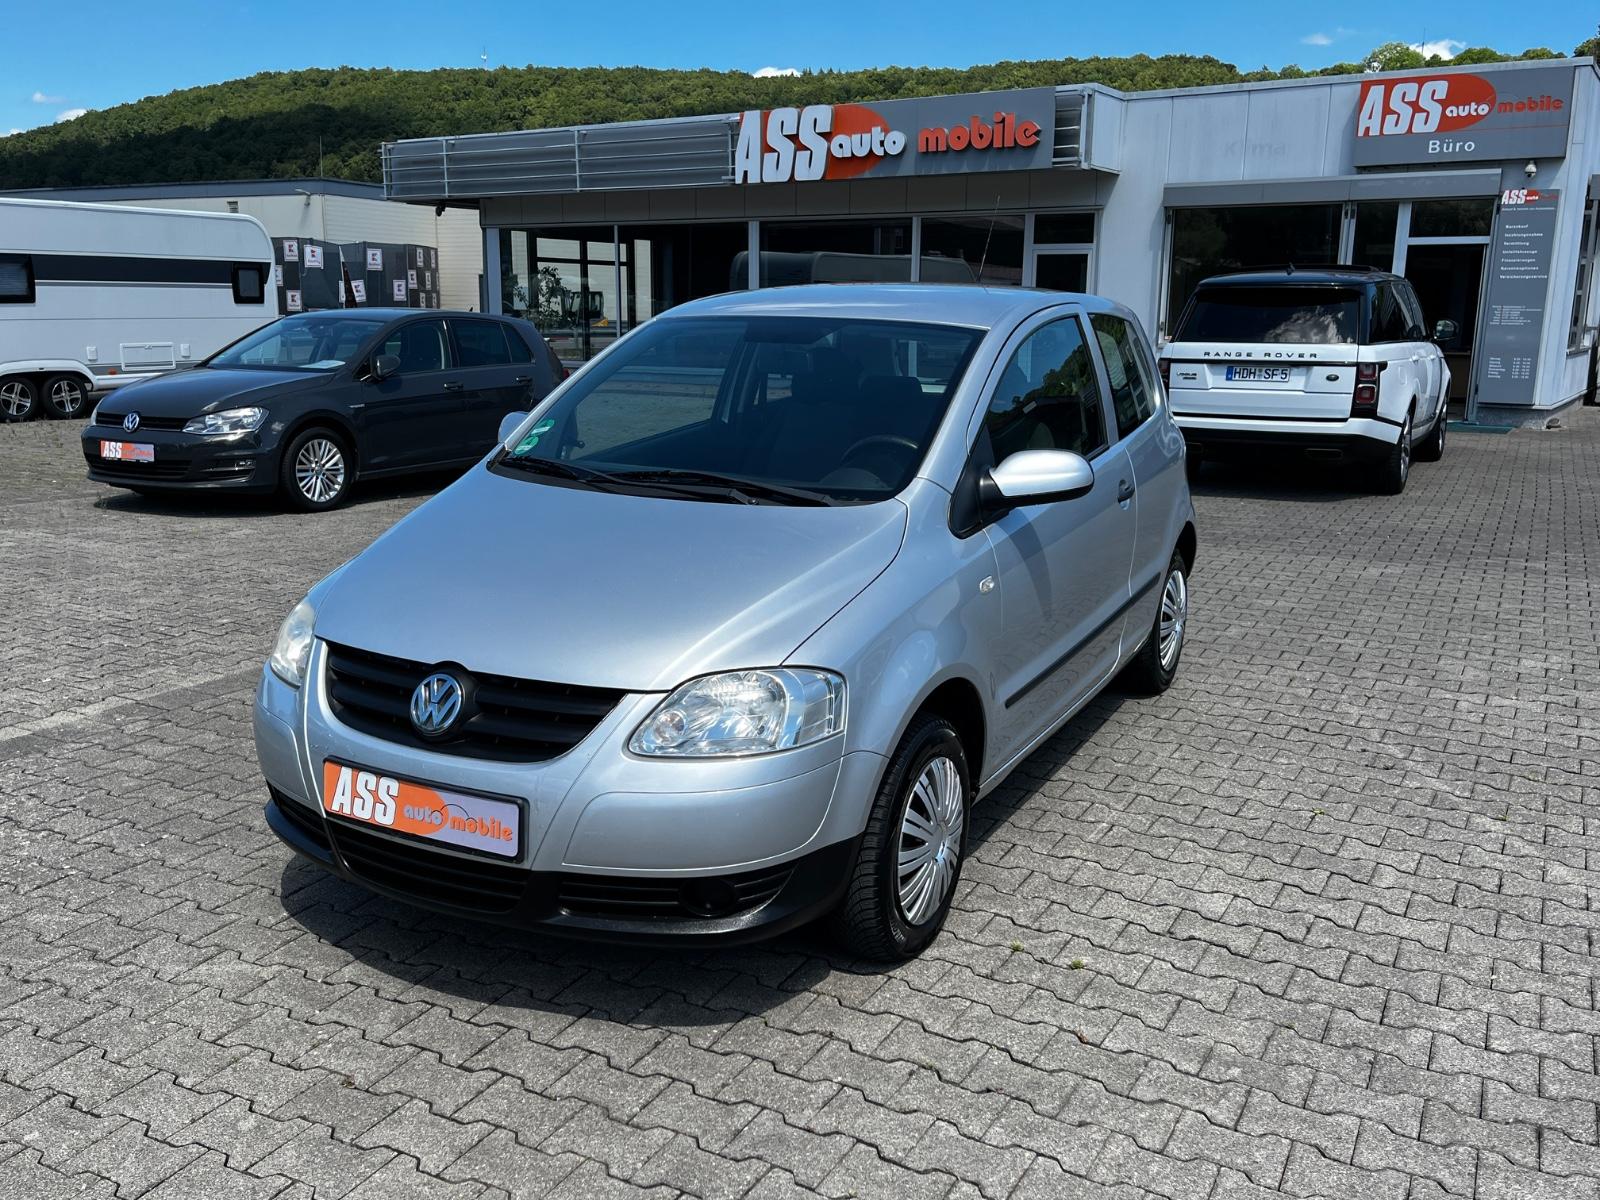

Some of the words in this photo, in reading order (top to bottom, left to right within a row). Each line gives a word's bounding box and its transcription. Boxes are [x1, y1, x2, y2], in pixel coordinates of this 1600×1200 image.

[1357, 80, 1449, 137] ASS
[1445, 102, 1491, 118] auto
[1497, 94, 1565, 113] mobile
[734, 104, 833, 185] ASS
[830, 126, 907, 158] auto
[918, 111, 1041, 154] mobile
[1428, 139, 1476, 154] Büro
[1501, 189, 1528, 205] ASS
[1233, 367, 1257, 379] HDH
[103, 441, 123, 459] ASS
[331, 766, 400, 827] ASS
[403, 804, 444, 826] auto
[450, 814, 513, 842] mobile
